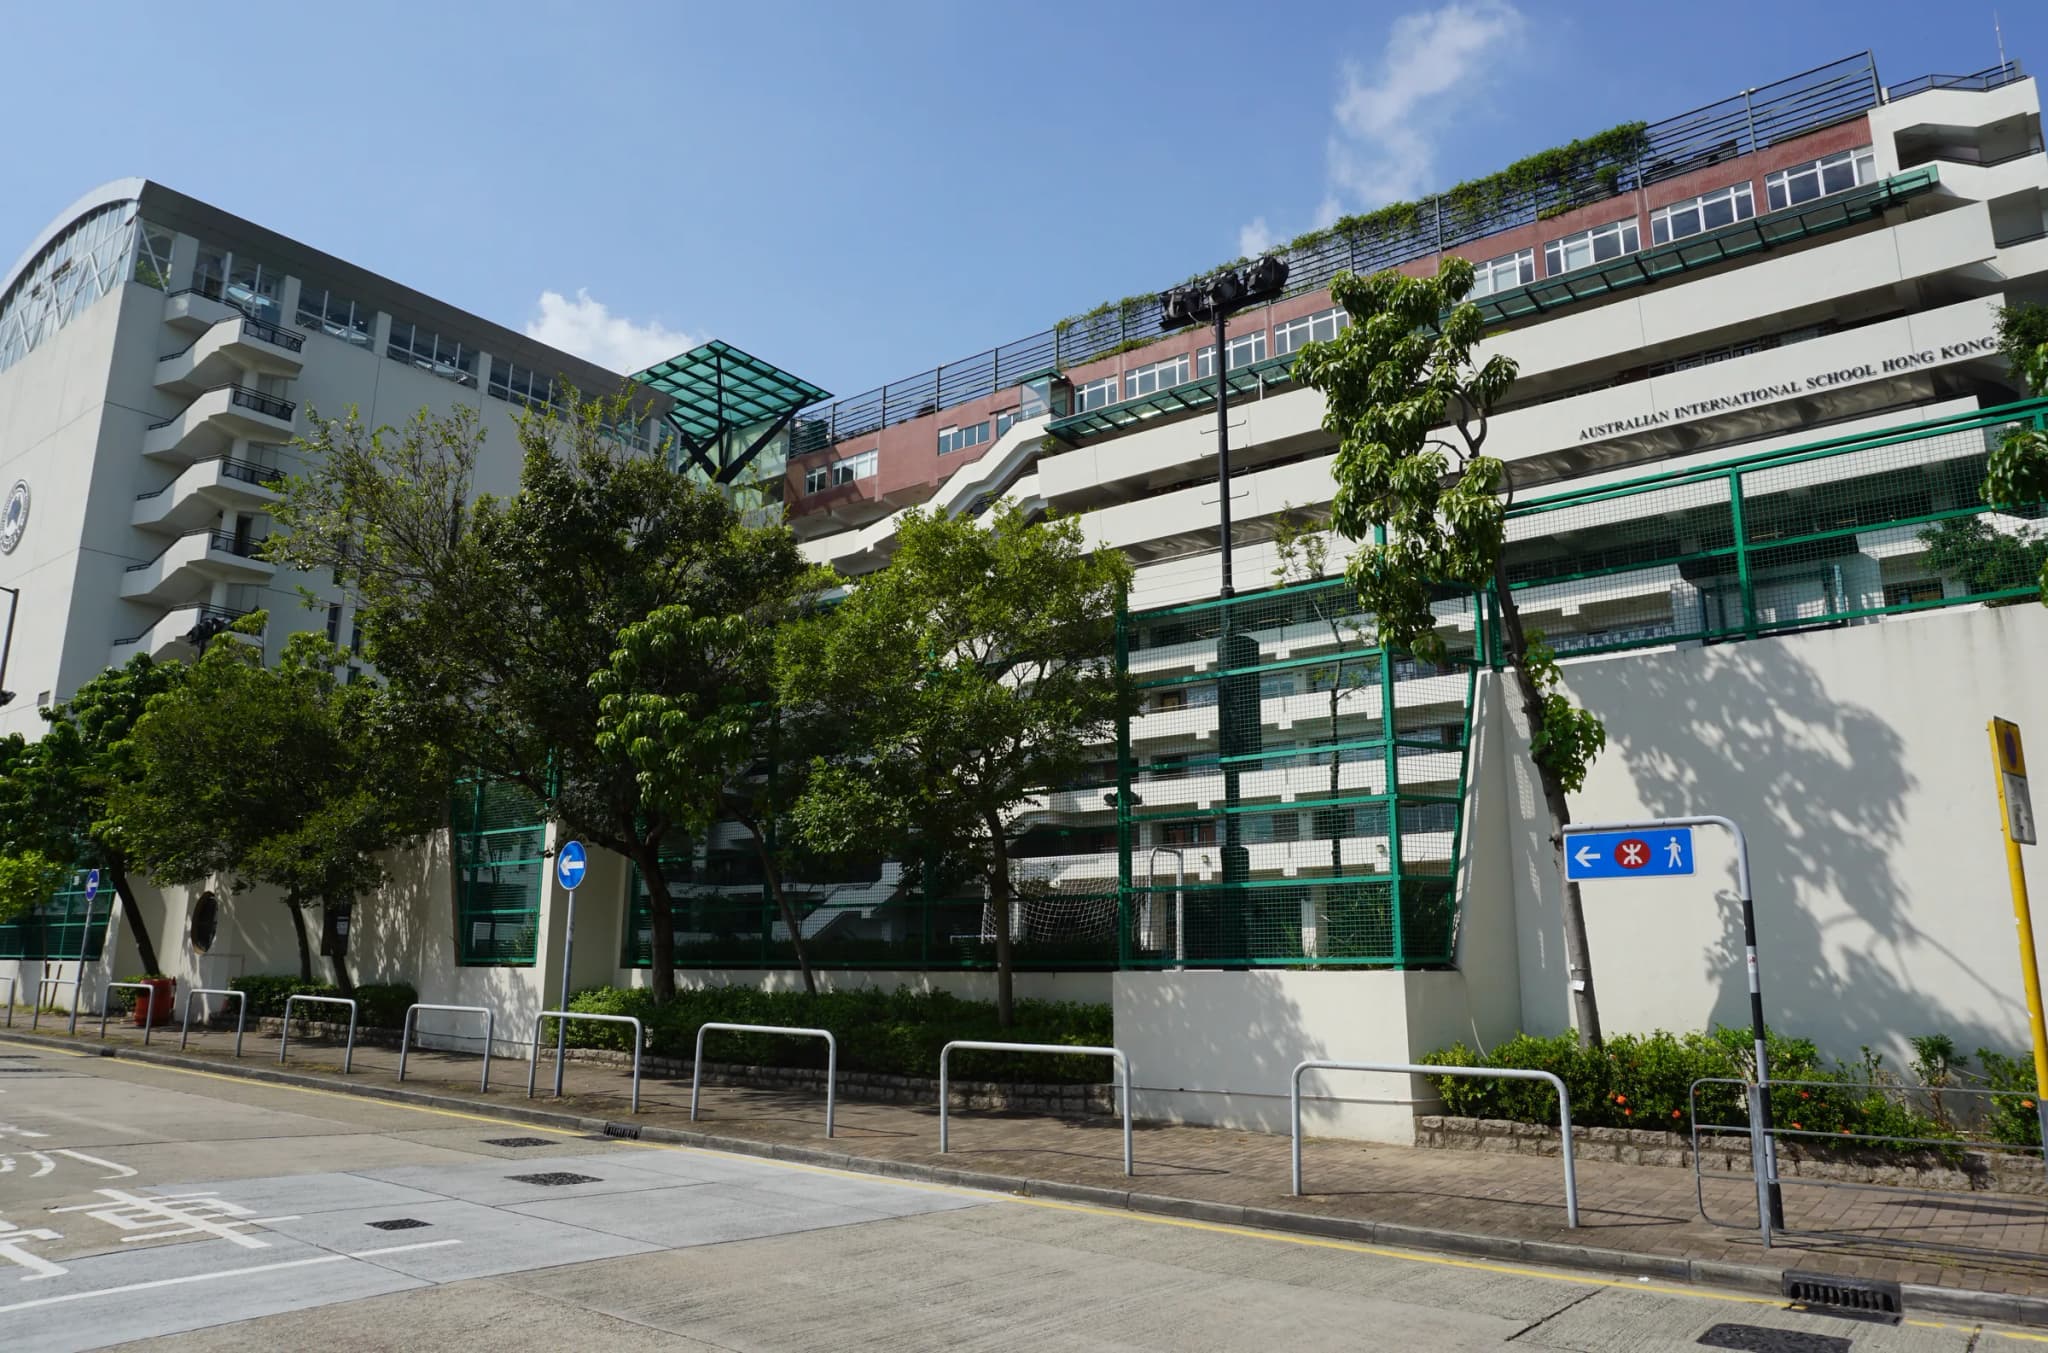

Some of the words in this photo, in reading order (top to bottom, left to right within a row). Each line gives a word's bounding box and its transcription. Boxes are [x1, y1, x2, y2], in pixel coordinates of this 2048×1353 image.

[1579, 410, 1670, 440] AUSTRALIAN
[1674, 381, 1802, 419] INTERNATIONAL
[1806, 364, 1878, 390] SCHOOL
[1882, 350, 1935, 373] HONG
[1940, 336, 1996, 359] KONG
